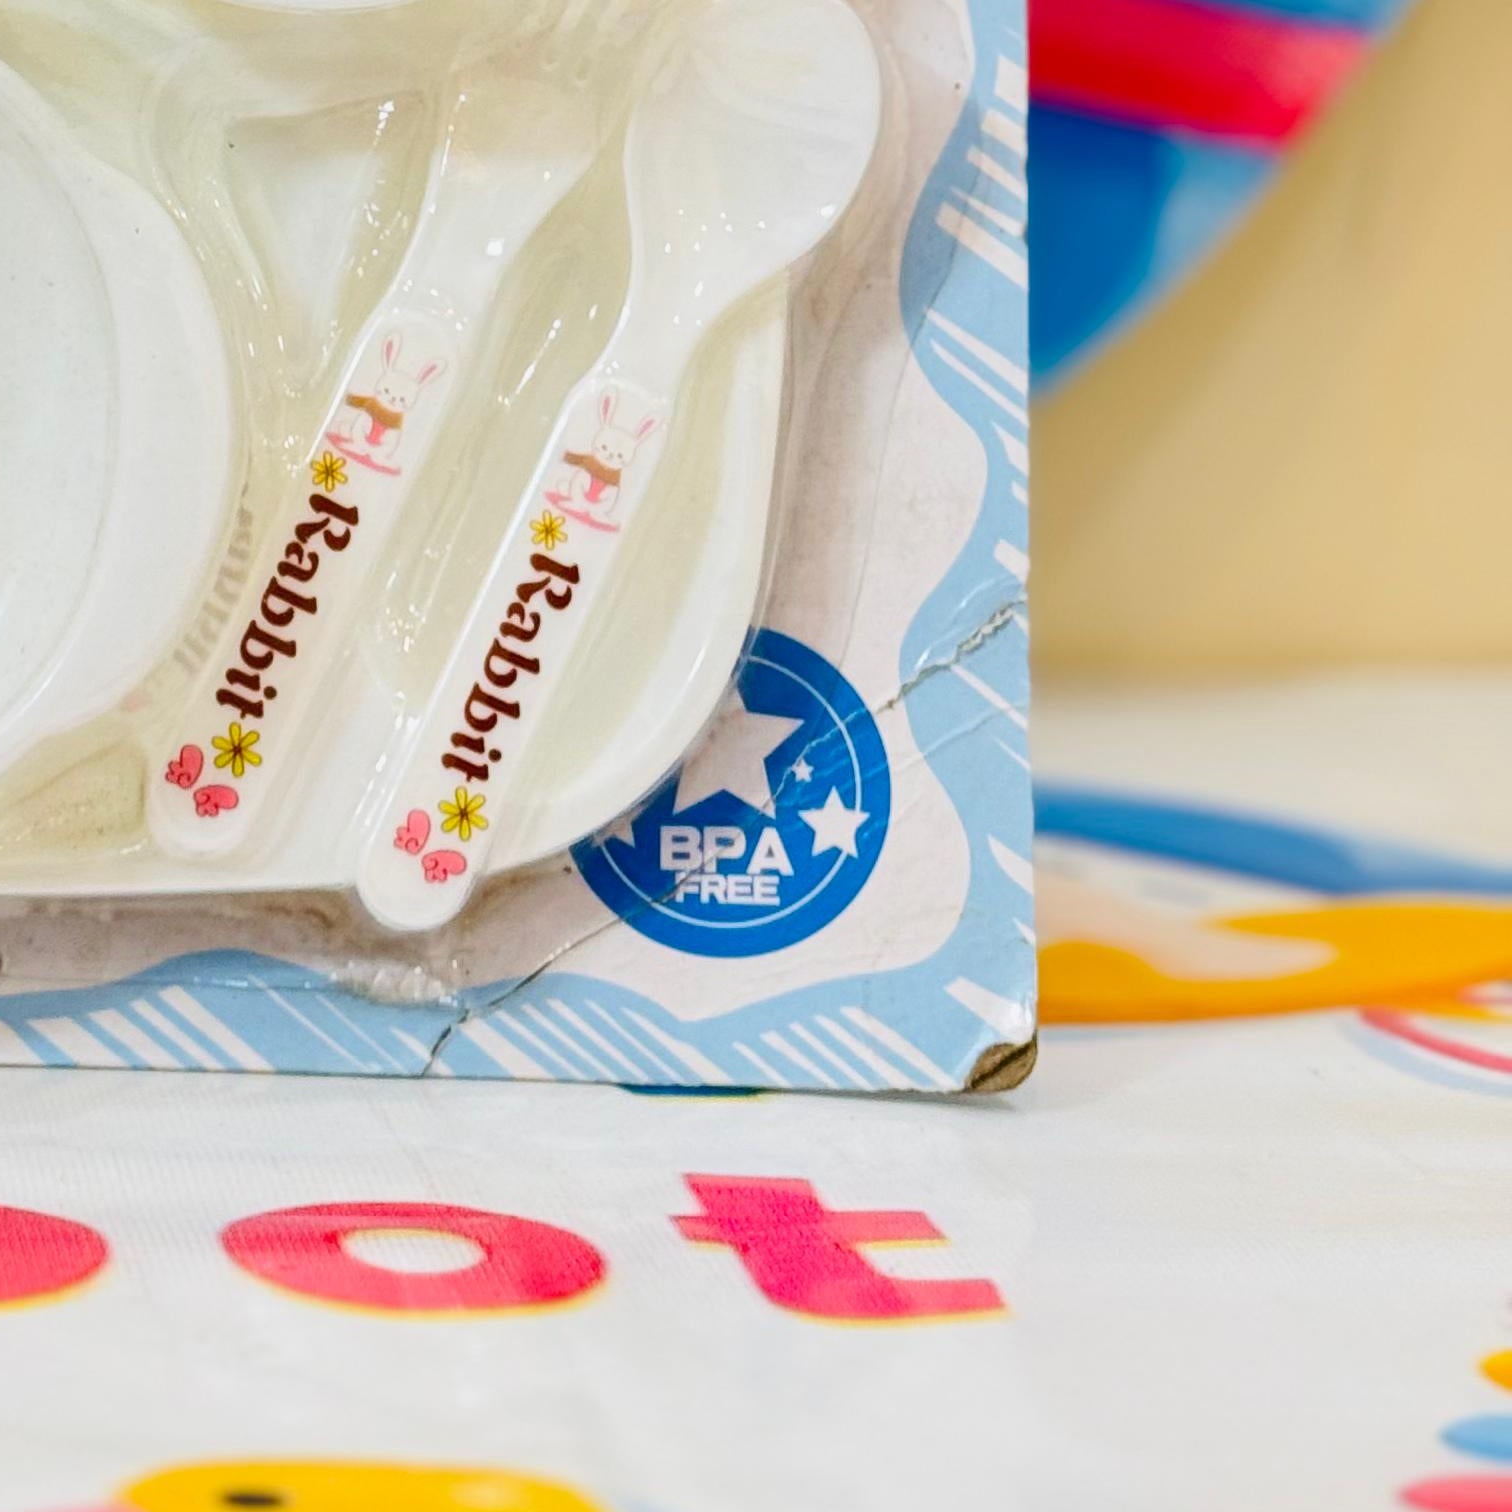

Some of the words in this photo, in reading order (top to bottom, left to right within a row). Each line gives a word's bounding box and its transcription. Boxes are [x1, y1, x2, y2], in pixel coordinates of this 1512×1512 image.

[215, 493, 359, 719] Rabbit
[442, 552, 580, 782] Rabbit
[658, 824, 794, 876] BPA
[674, 871, 780, 906] FREE
